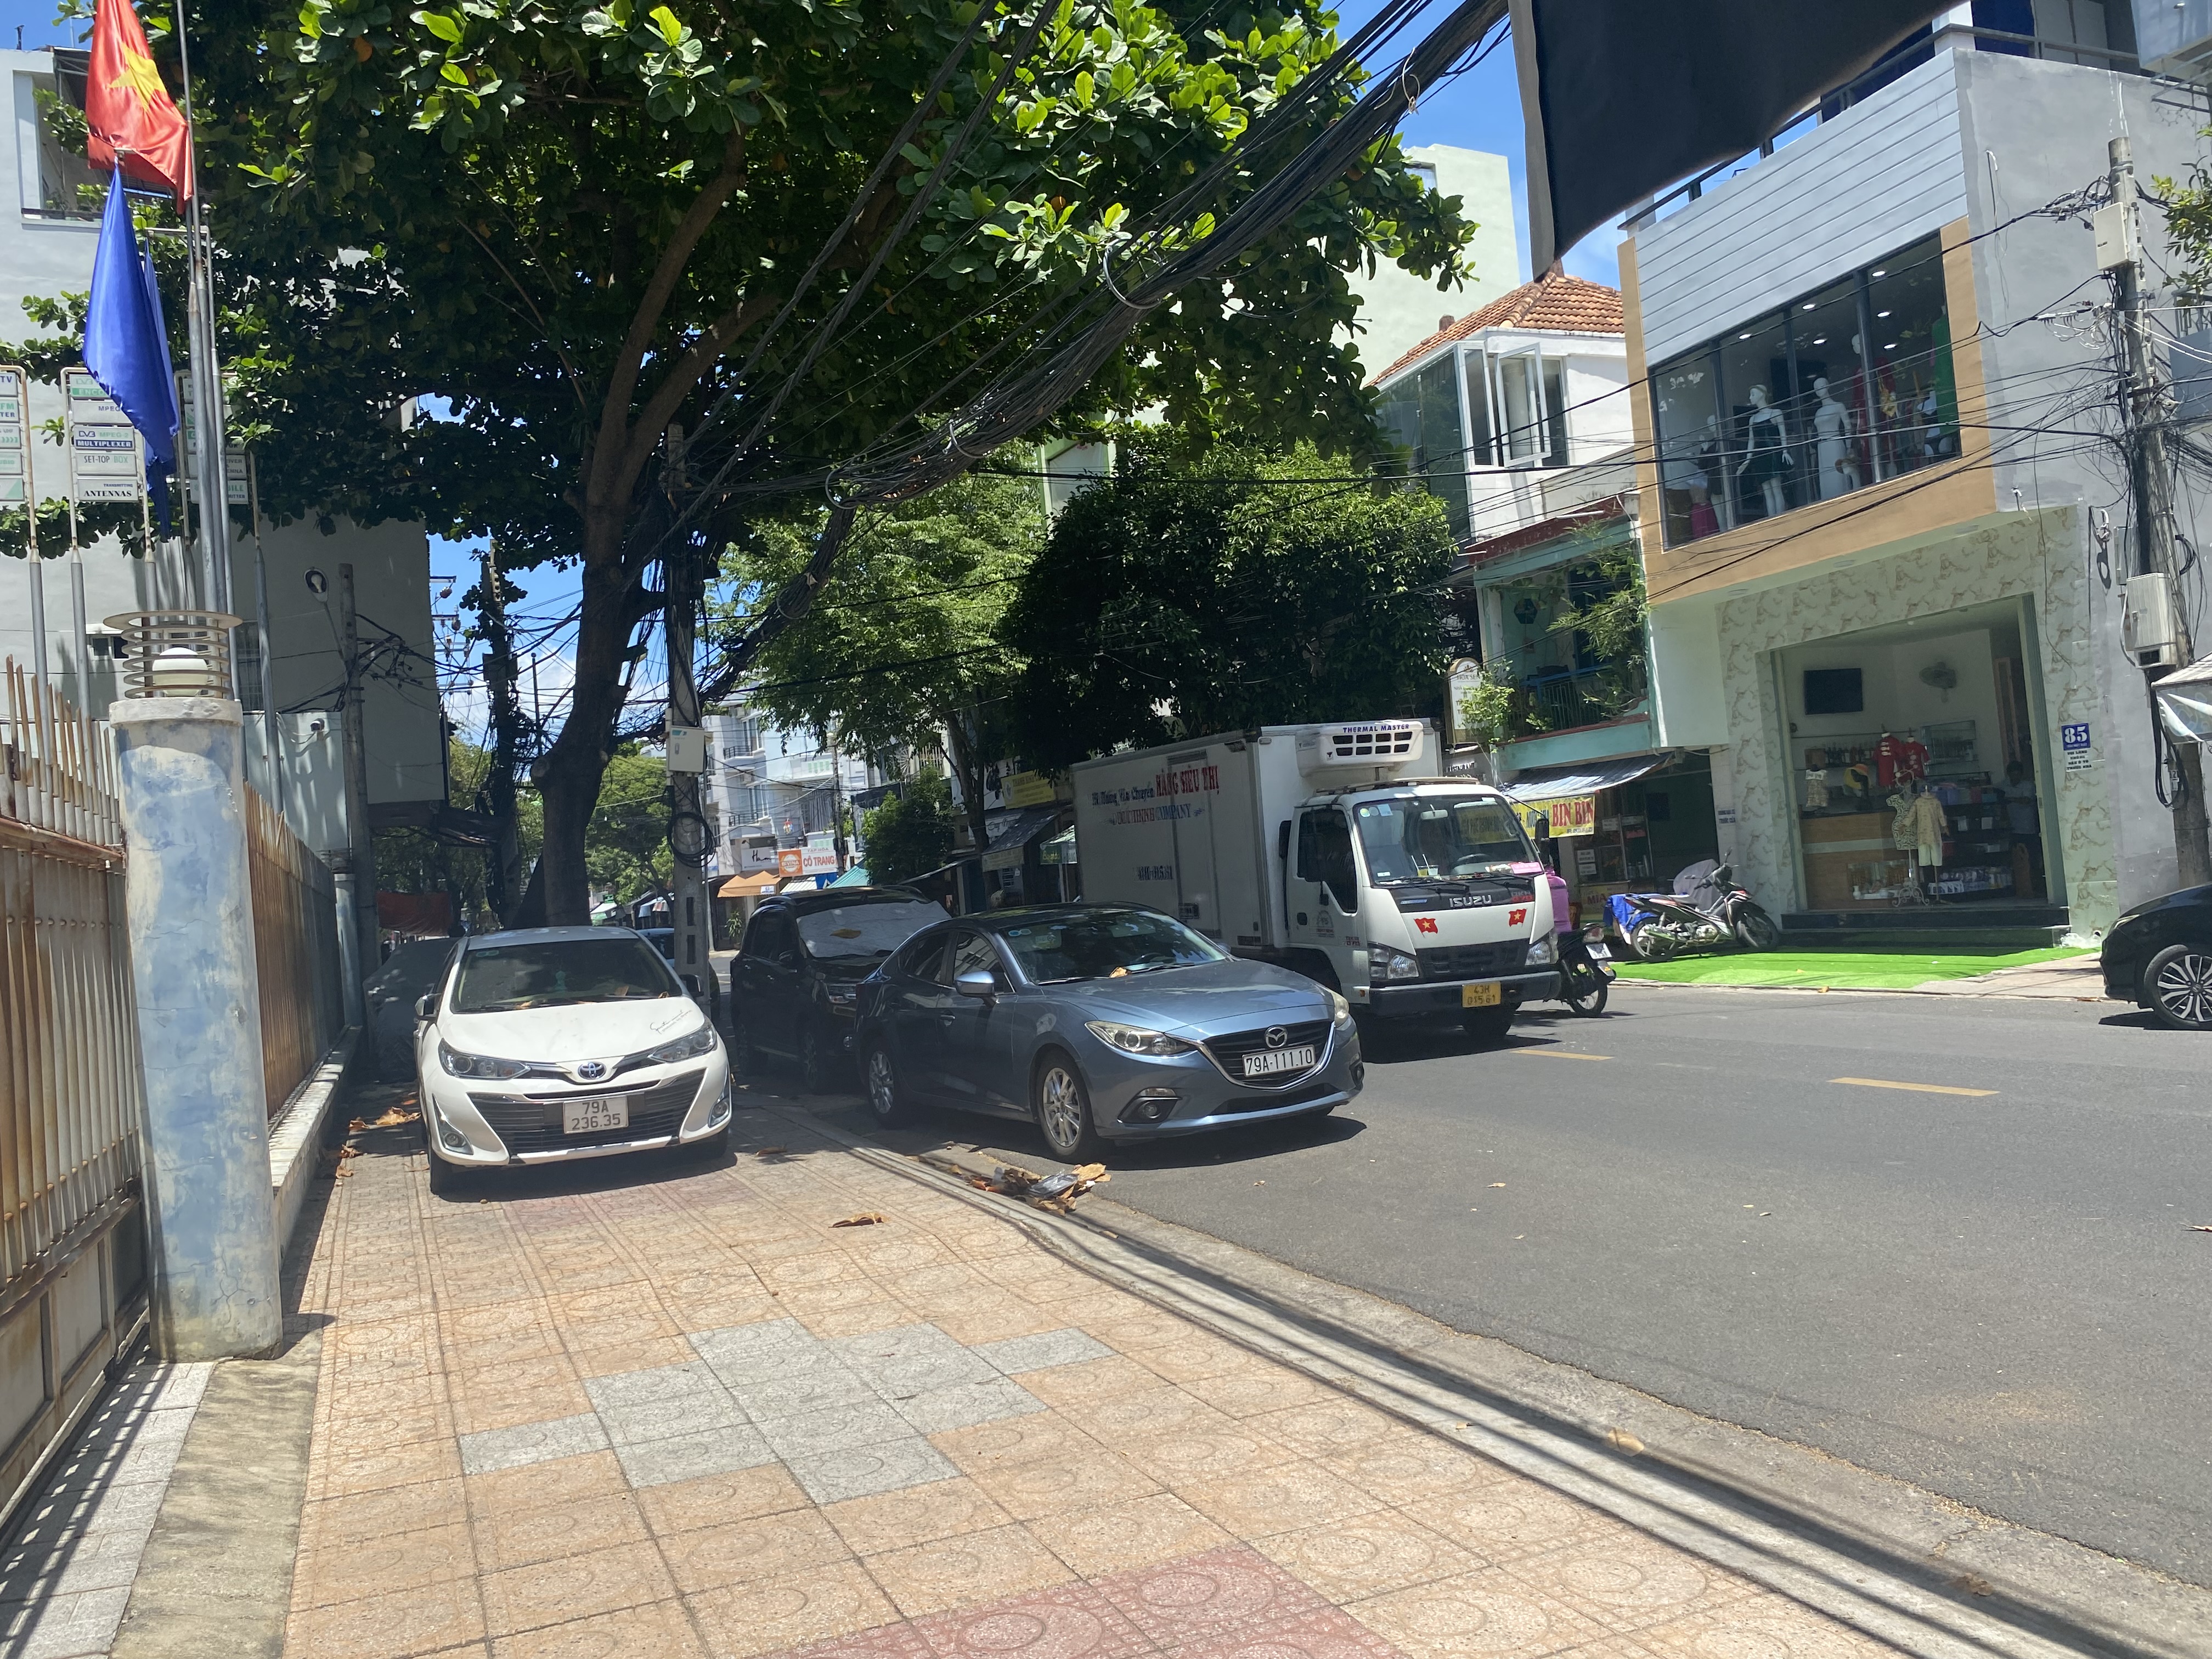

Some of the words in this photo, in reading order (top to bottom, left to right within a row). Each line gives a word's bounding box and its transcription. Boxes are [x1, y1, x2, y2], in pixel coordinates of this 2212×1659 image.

[2064, 726, 2087, 743] 85
[1552, 803, 1571, 827] BIN
[1575, 801, 1593, 825] BIN
[803, 855, 812, 867] CÔ
[813, 856, 834, 866] TRANG
[1449, 895, 1492, 907] ISUZU
[582, 1101, 609, 1114] 79A
[572, 1113, 620, 1130] 236.35
